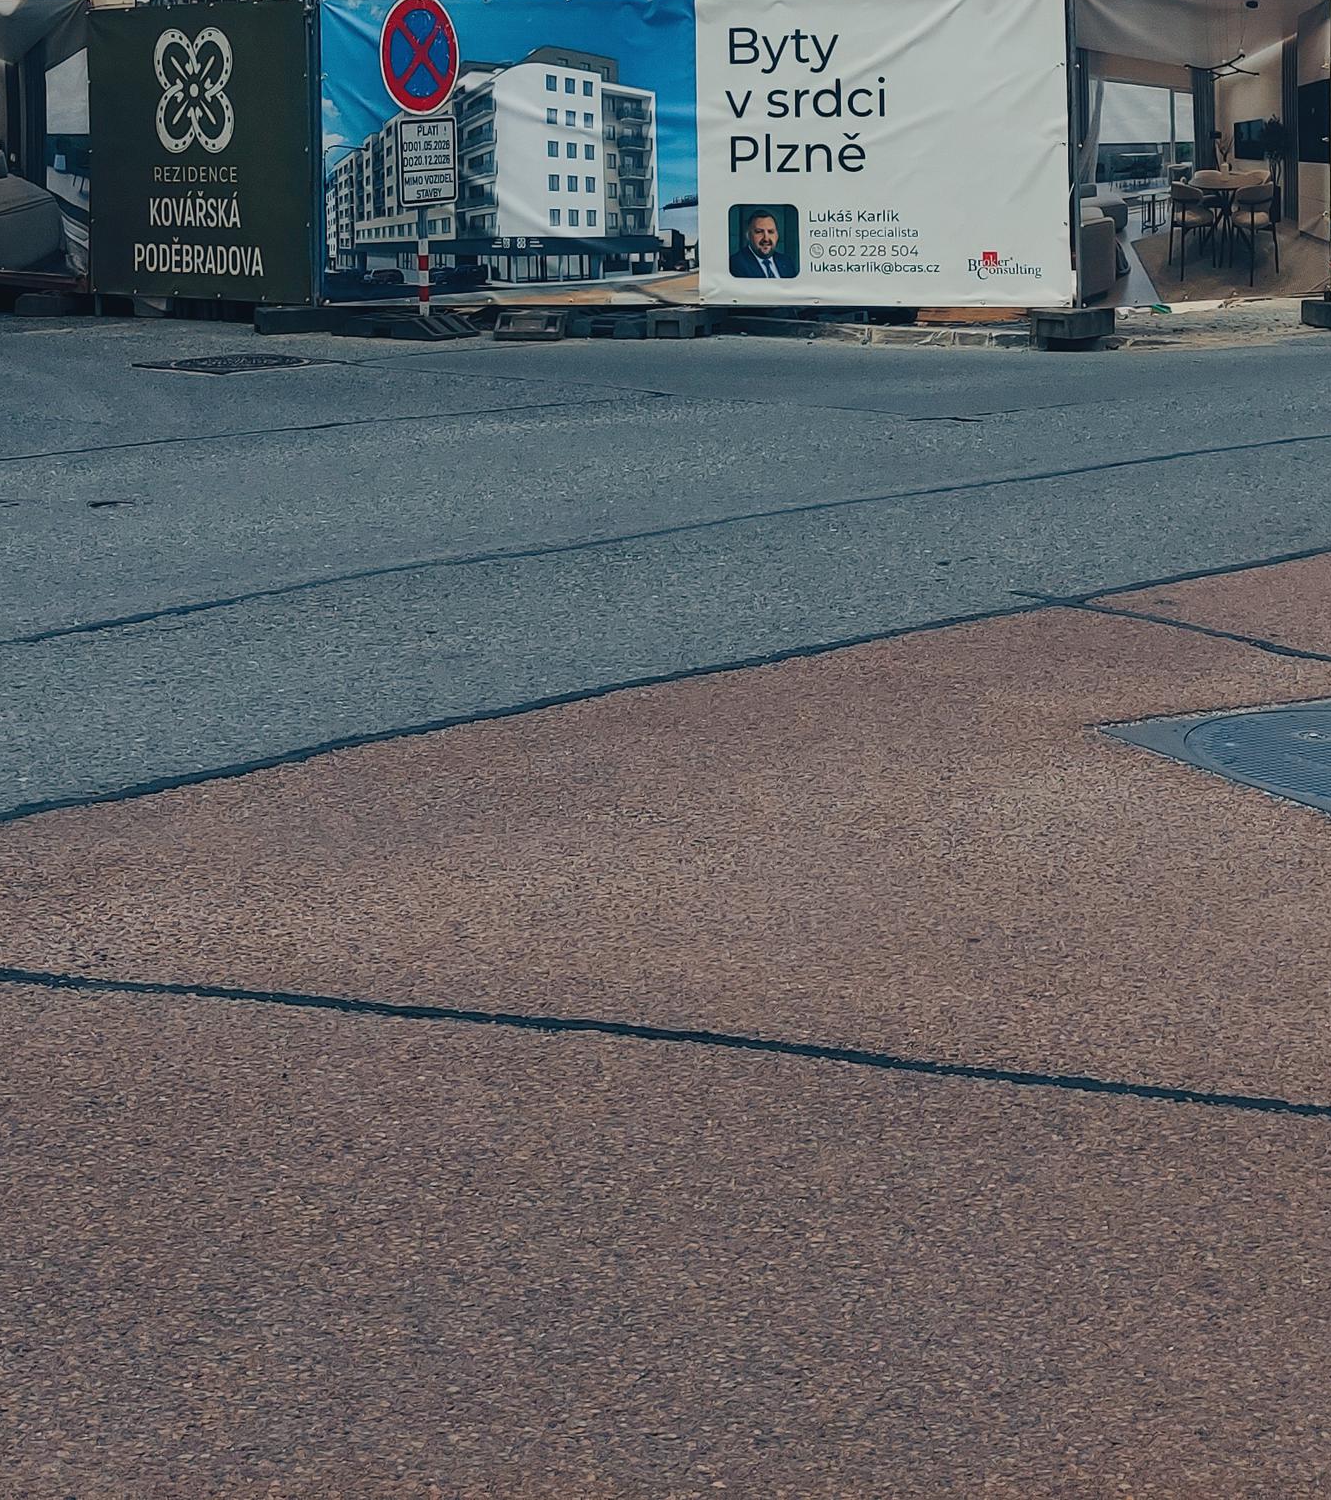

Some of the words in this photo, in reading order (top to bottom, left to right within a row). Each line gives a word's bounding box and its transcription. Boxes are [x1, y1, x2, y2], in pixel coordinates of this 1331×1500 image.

[728, 27, 839, 74] Byty
[724, 90, 752, 118] v
[767, 76, 885, 118] srdci
[730, 132, 866, 173] Plzně
[154, 166, 238, 182] REZIDENCE
[405, 176, 423, 186] MIMO
[424, 173, 453, 184] VOZIDEL
[417, 188, 442, 198] STAVBY
[149, 190, 241, 228] KOVÁŘSKÁ
[809, 210, 852, 223] Lukáš
[857, 210, 899, 222] Karlík
[809, 227, 852, 238] realitní
[855, 227, 918, 239] specialista
[134, 236, 264, 276] PODĚBRADOVA
[829, 245, 856, 257] 602
[860, 245, 887, 257] 228
[891, 245, 919, 257] 504
[977, 263, 1042, 280] Consulting
